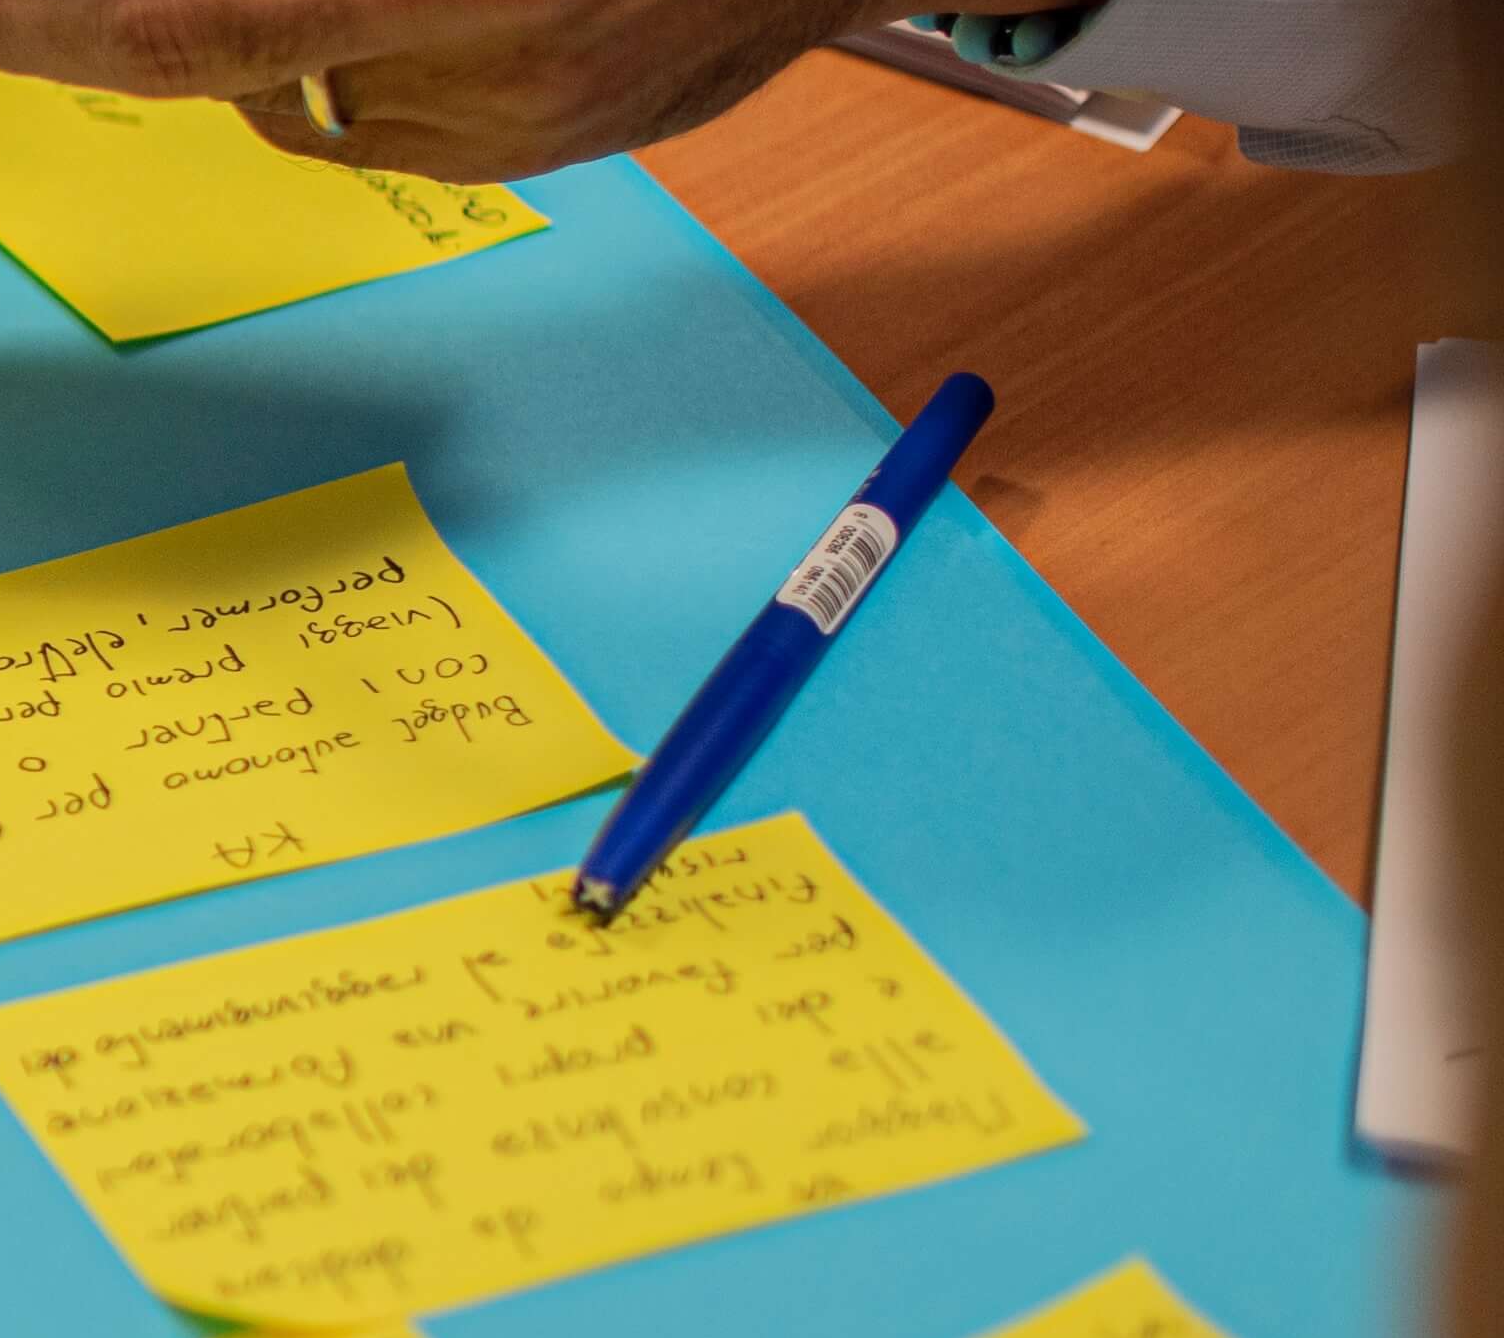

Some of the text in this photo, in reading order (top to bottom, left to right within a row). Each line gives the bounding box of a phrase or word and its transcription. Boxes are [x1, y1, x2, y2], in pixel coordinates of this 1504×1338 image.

[102, 640, 249, 702] premio
[123, 684, 318, 753] partner
[388, 691, 536, 747] Budget
[15, 753, 51, 776] o
[160, 728, 364, 793] autonomo
[33, 770, 116, 824] per
[210, 818, 308, 873] KA
[772, 912, 864, 964] per
[387, 1015, 480, 1053] una
